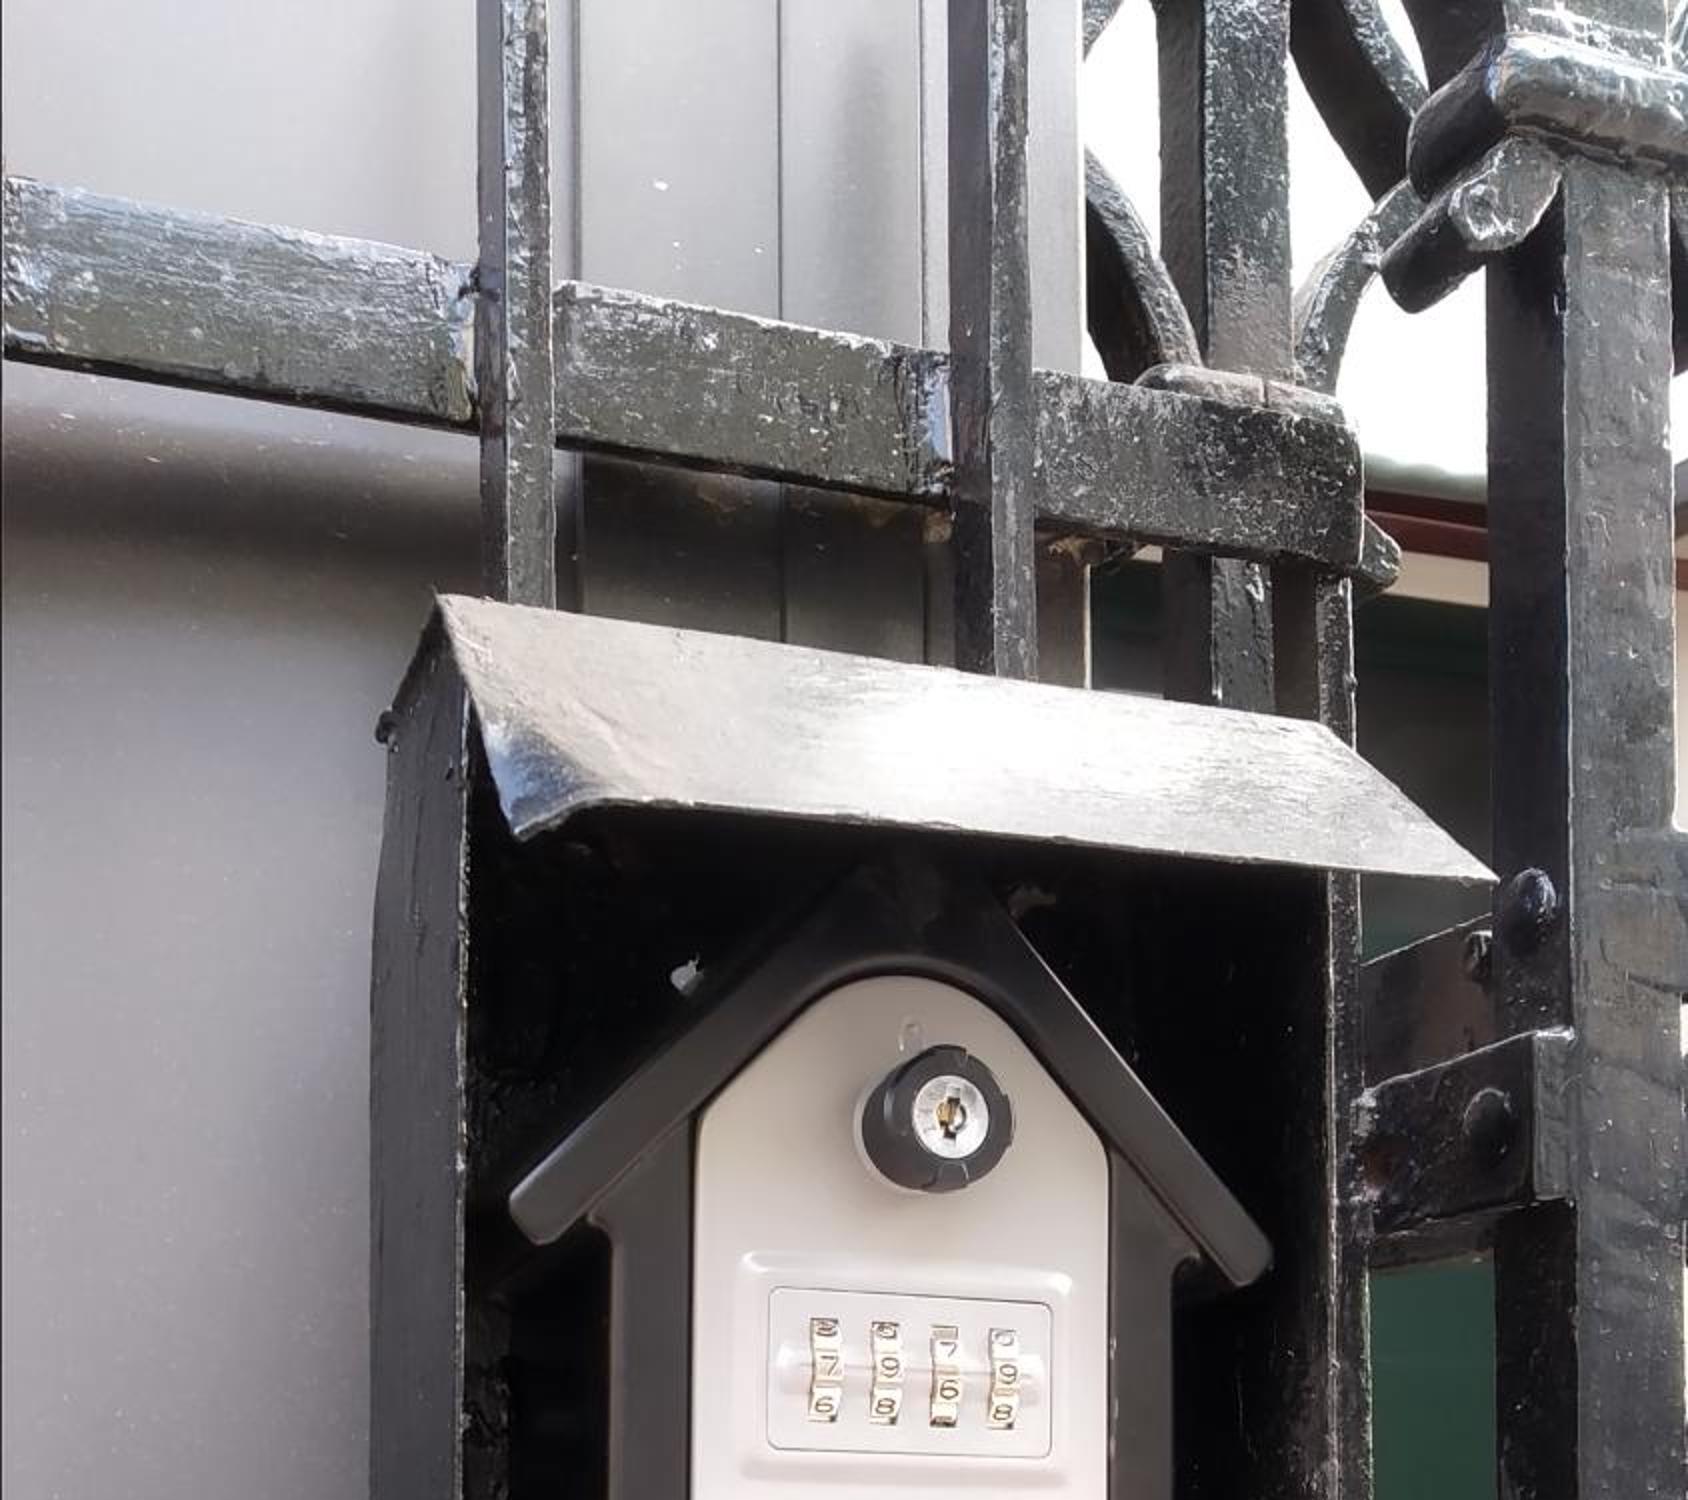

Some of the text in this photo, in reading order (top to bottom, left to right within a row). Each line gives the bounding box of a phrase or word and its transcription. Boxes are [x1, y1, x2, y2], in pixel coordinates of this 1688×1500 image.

[940, 1341, 958, 1358] 7
[820, 1355, 1018, 1400] 7 9 6 9
[815, 1396, 1013, 1421] 6 8 8
